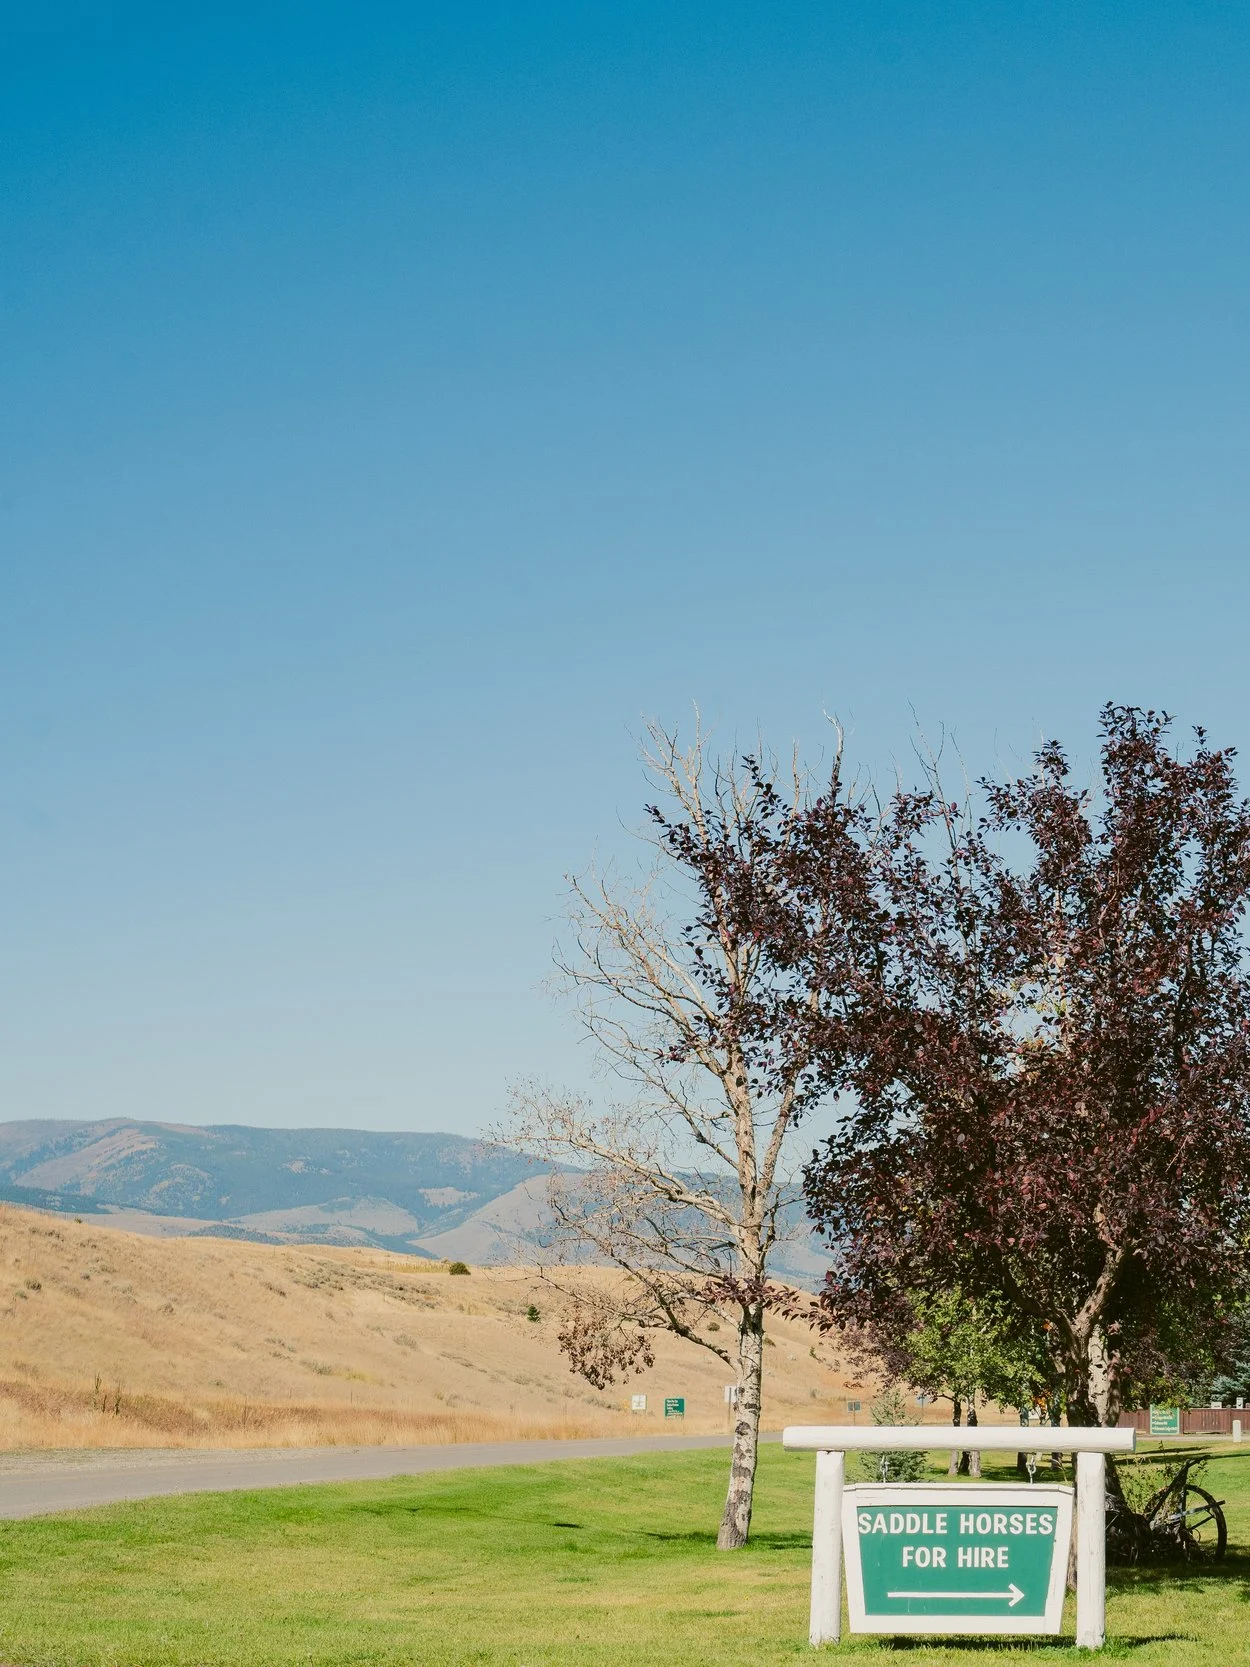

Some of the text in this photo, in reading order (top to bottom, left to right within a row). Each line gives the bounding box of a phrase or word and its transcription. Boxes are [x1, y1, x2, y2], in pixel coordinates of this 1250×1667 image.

[858, 1513, 1053, 1535] SADDLE HORSES
[902, 1546, 1009, 1568] FOR HIRE
